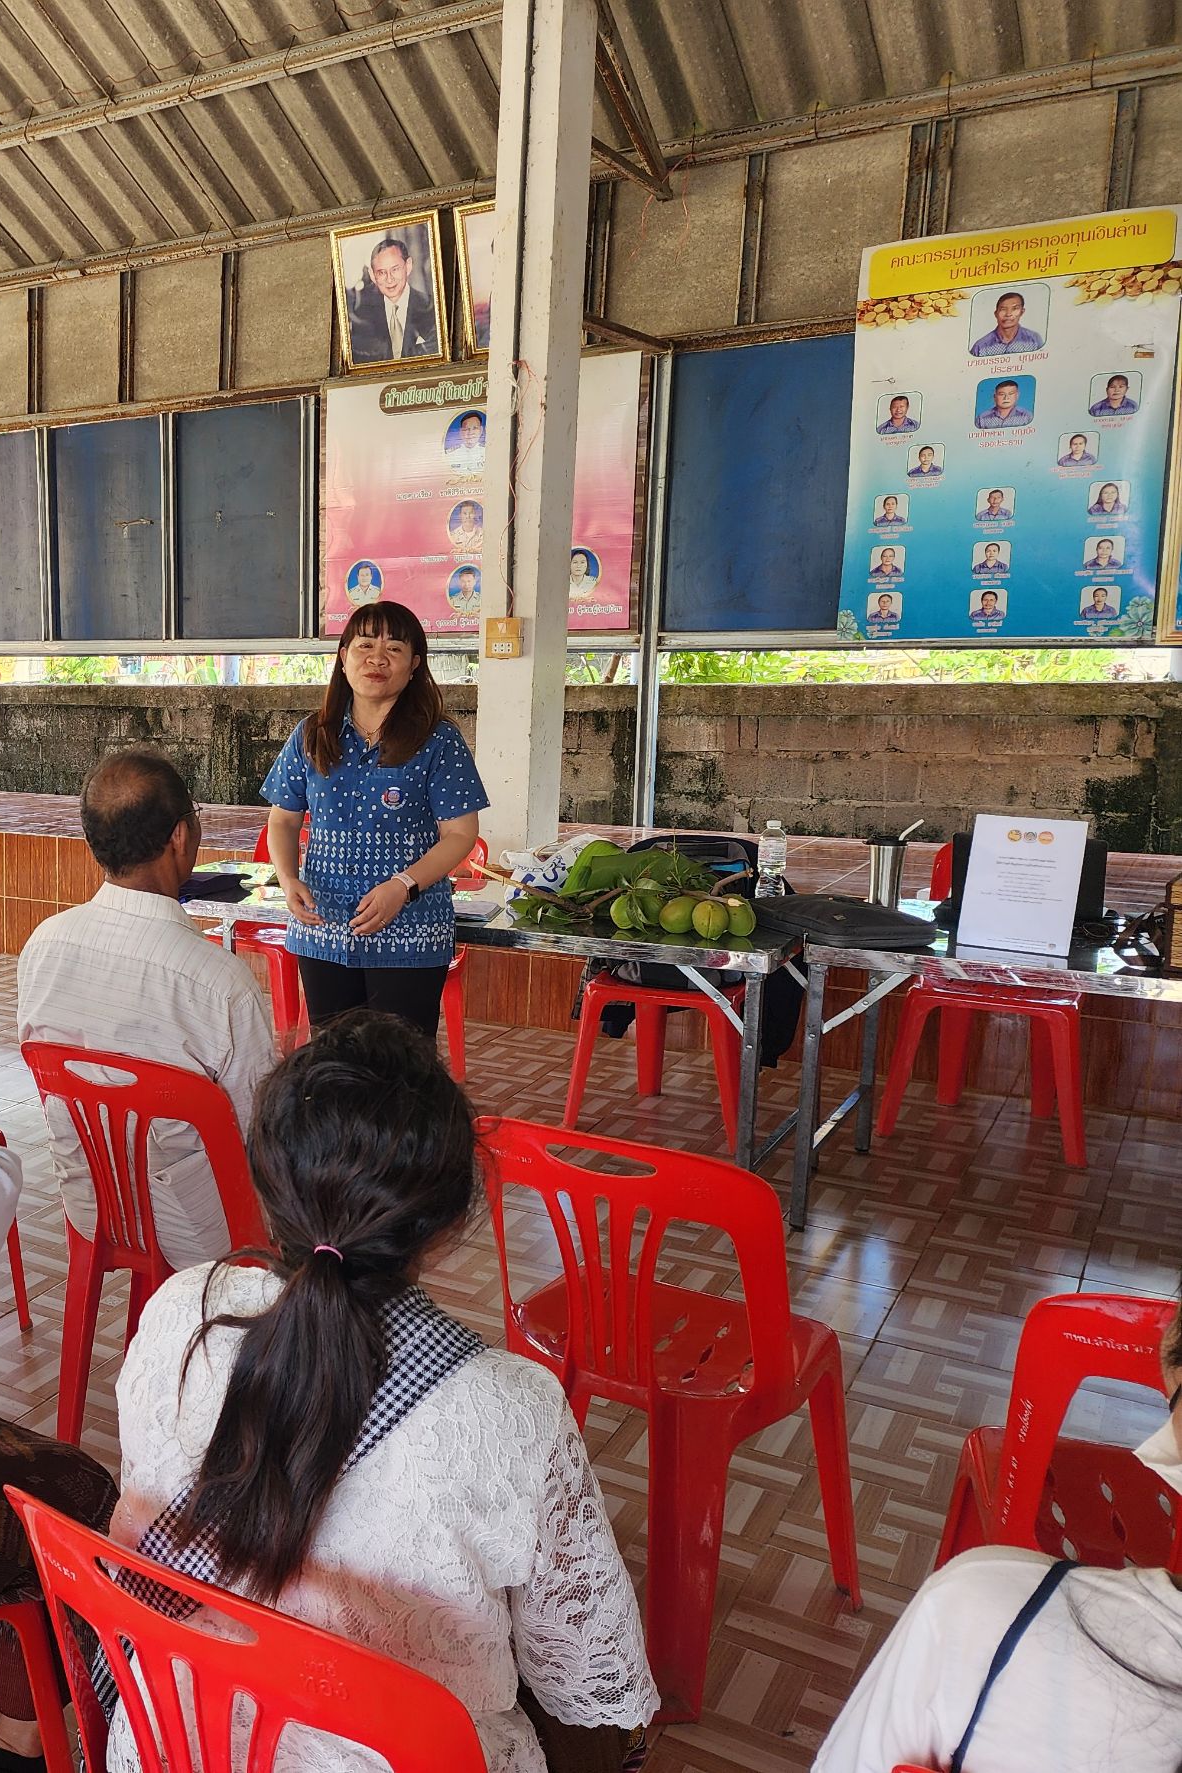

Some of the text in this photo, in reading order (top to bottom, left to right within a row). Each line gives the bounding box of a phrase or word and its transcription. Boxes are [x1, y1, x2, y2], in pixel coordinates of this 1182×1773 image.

[890, 218, 1147, 269] คณะกรรมการบริหารกองทุนเงินล้าน
[950, 249, 1077, 280] บ้านสำโรง หมู่ที่ 7
[385, 377, 489, 408] ทำเนียบผู้ใหญ่บ้า
